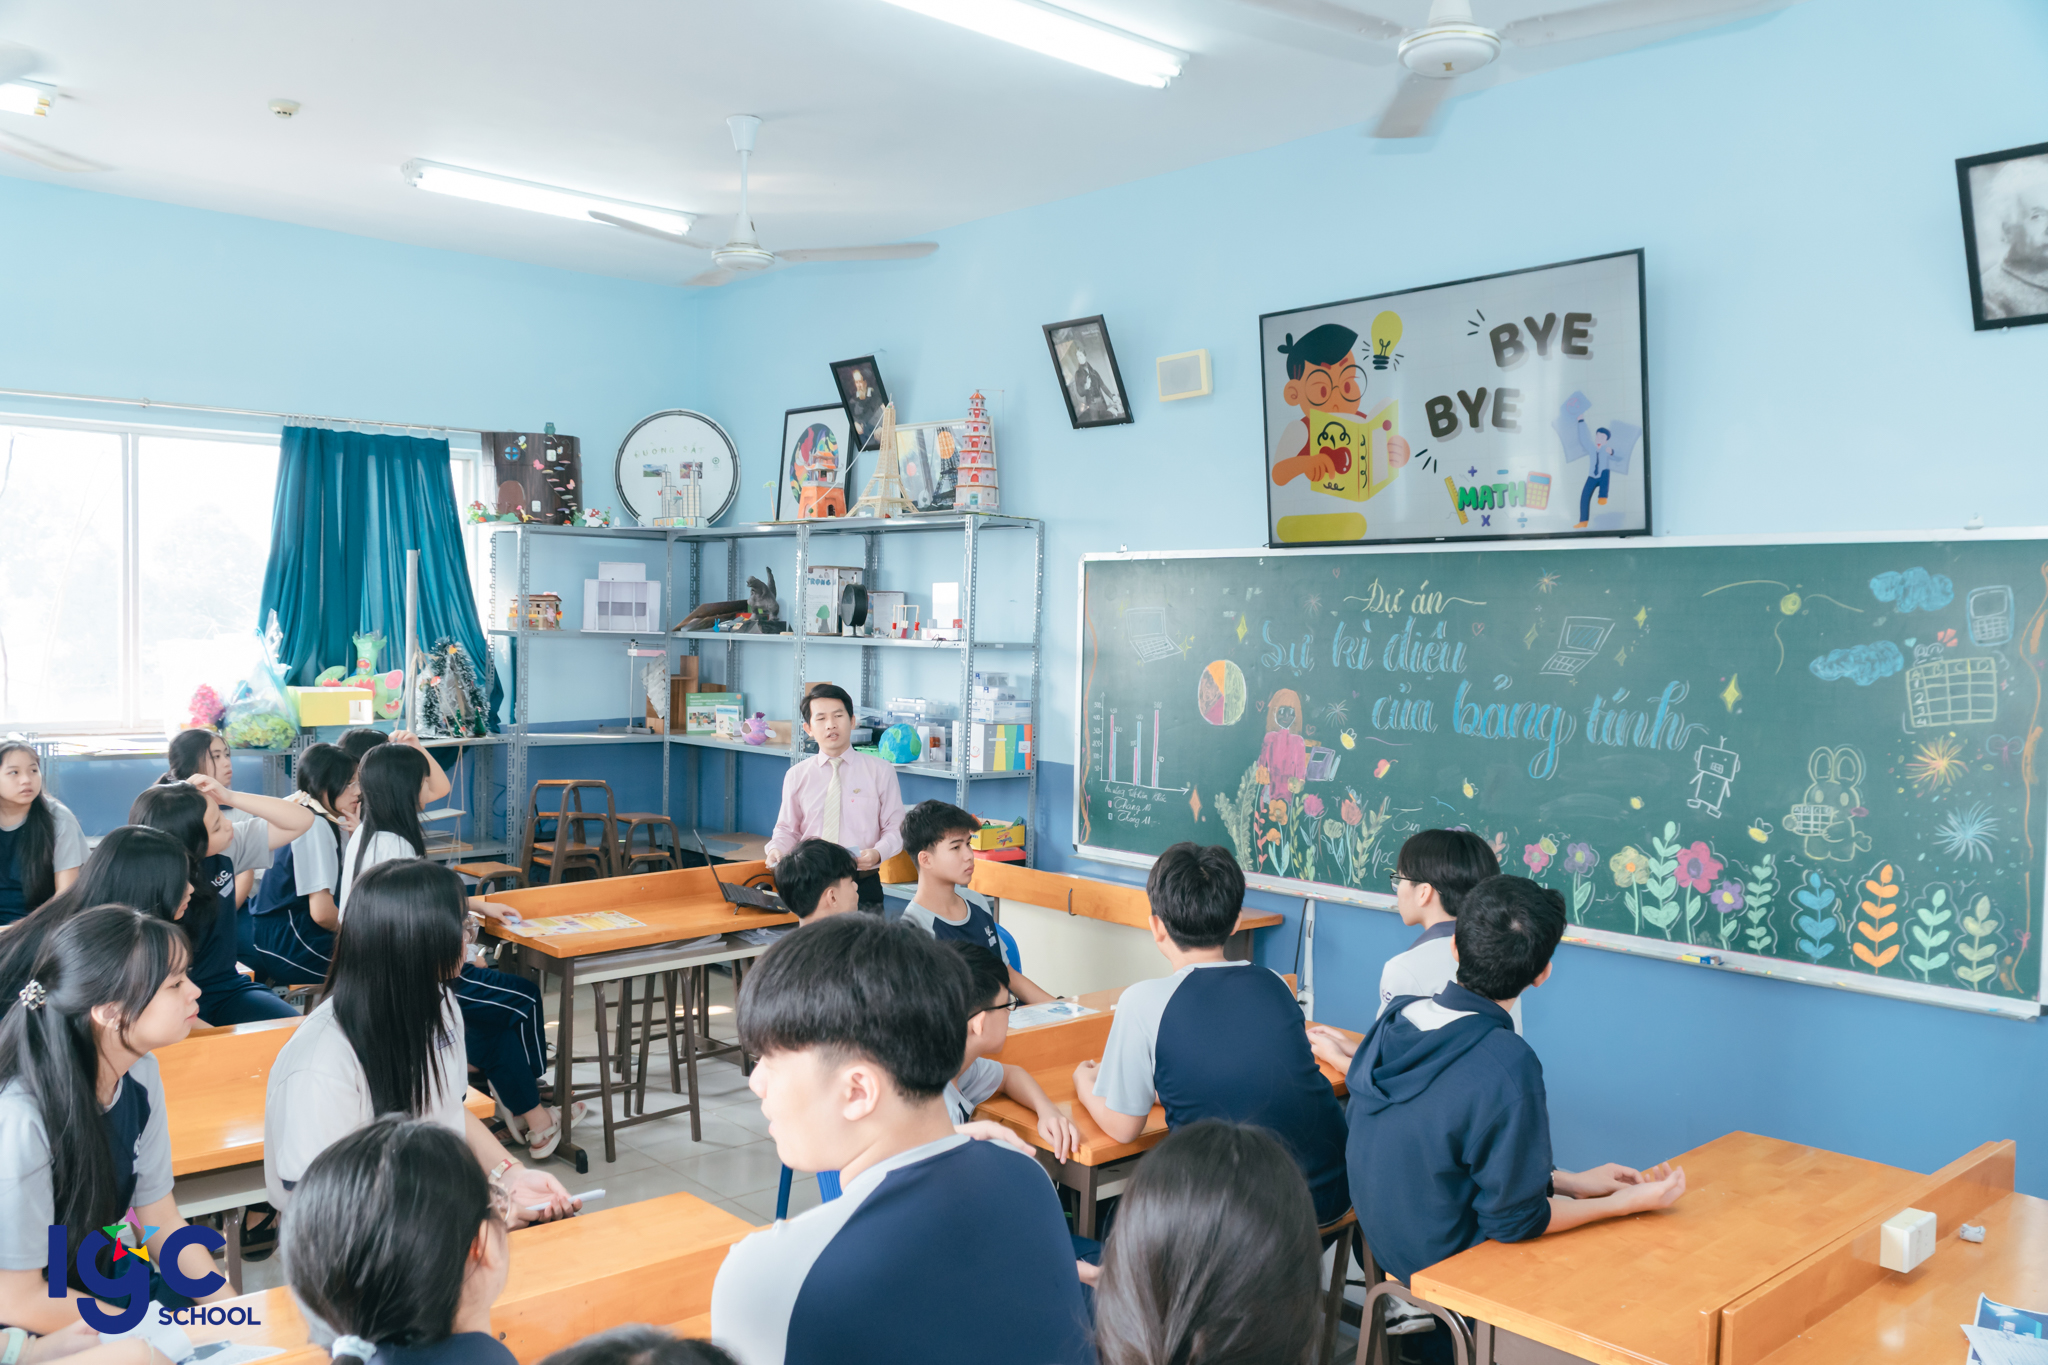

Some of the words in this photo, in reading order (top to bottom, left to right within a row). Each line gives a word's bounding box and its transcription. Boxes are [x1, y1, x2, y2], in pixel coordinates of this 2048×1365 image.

[1489, 312, 1594, 369] BYE
[1425, 387, 1520, 439] BYE
[1458, 481, 1527, 511] MATH
[1344, 577, 1405, 618] Dự
[1261, 620, 1315, 677] Sự
[1332, 619, 1373, 671] kì
[1383, 615, 1467, 680] diệu
[1914, 692, 1924, 704] 2
[1917, 706, 1926, 716] 3
[1372, 682, 1438, 733] của
[1453, 674, 1576, 780] bảng
[1583, 680, 1709, 751] tính
[1917, 718, 1927, 726] 4
